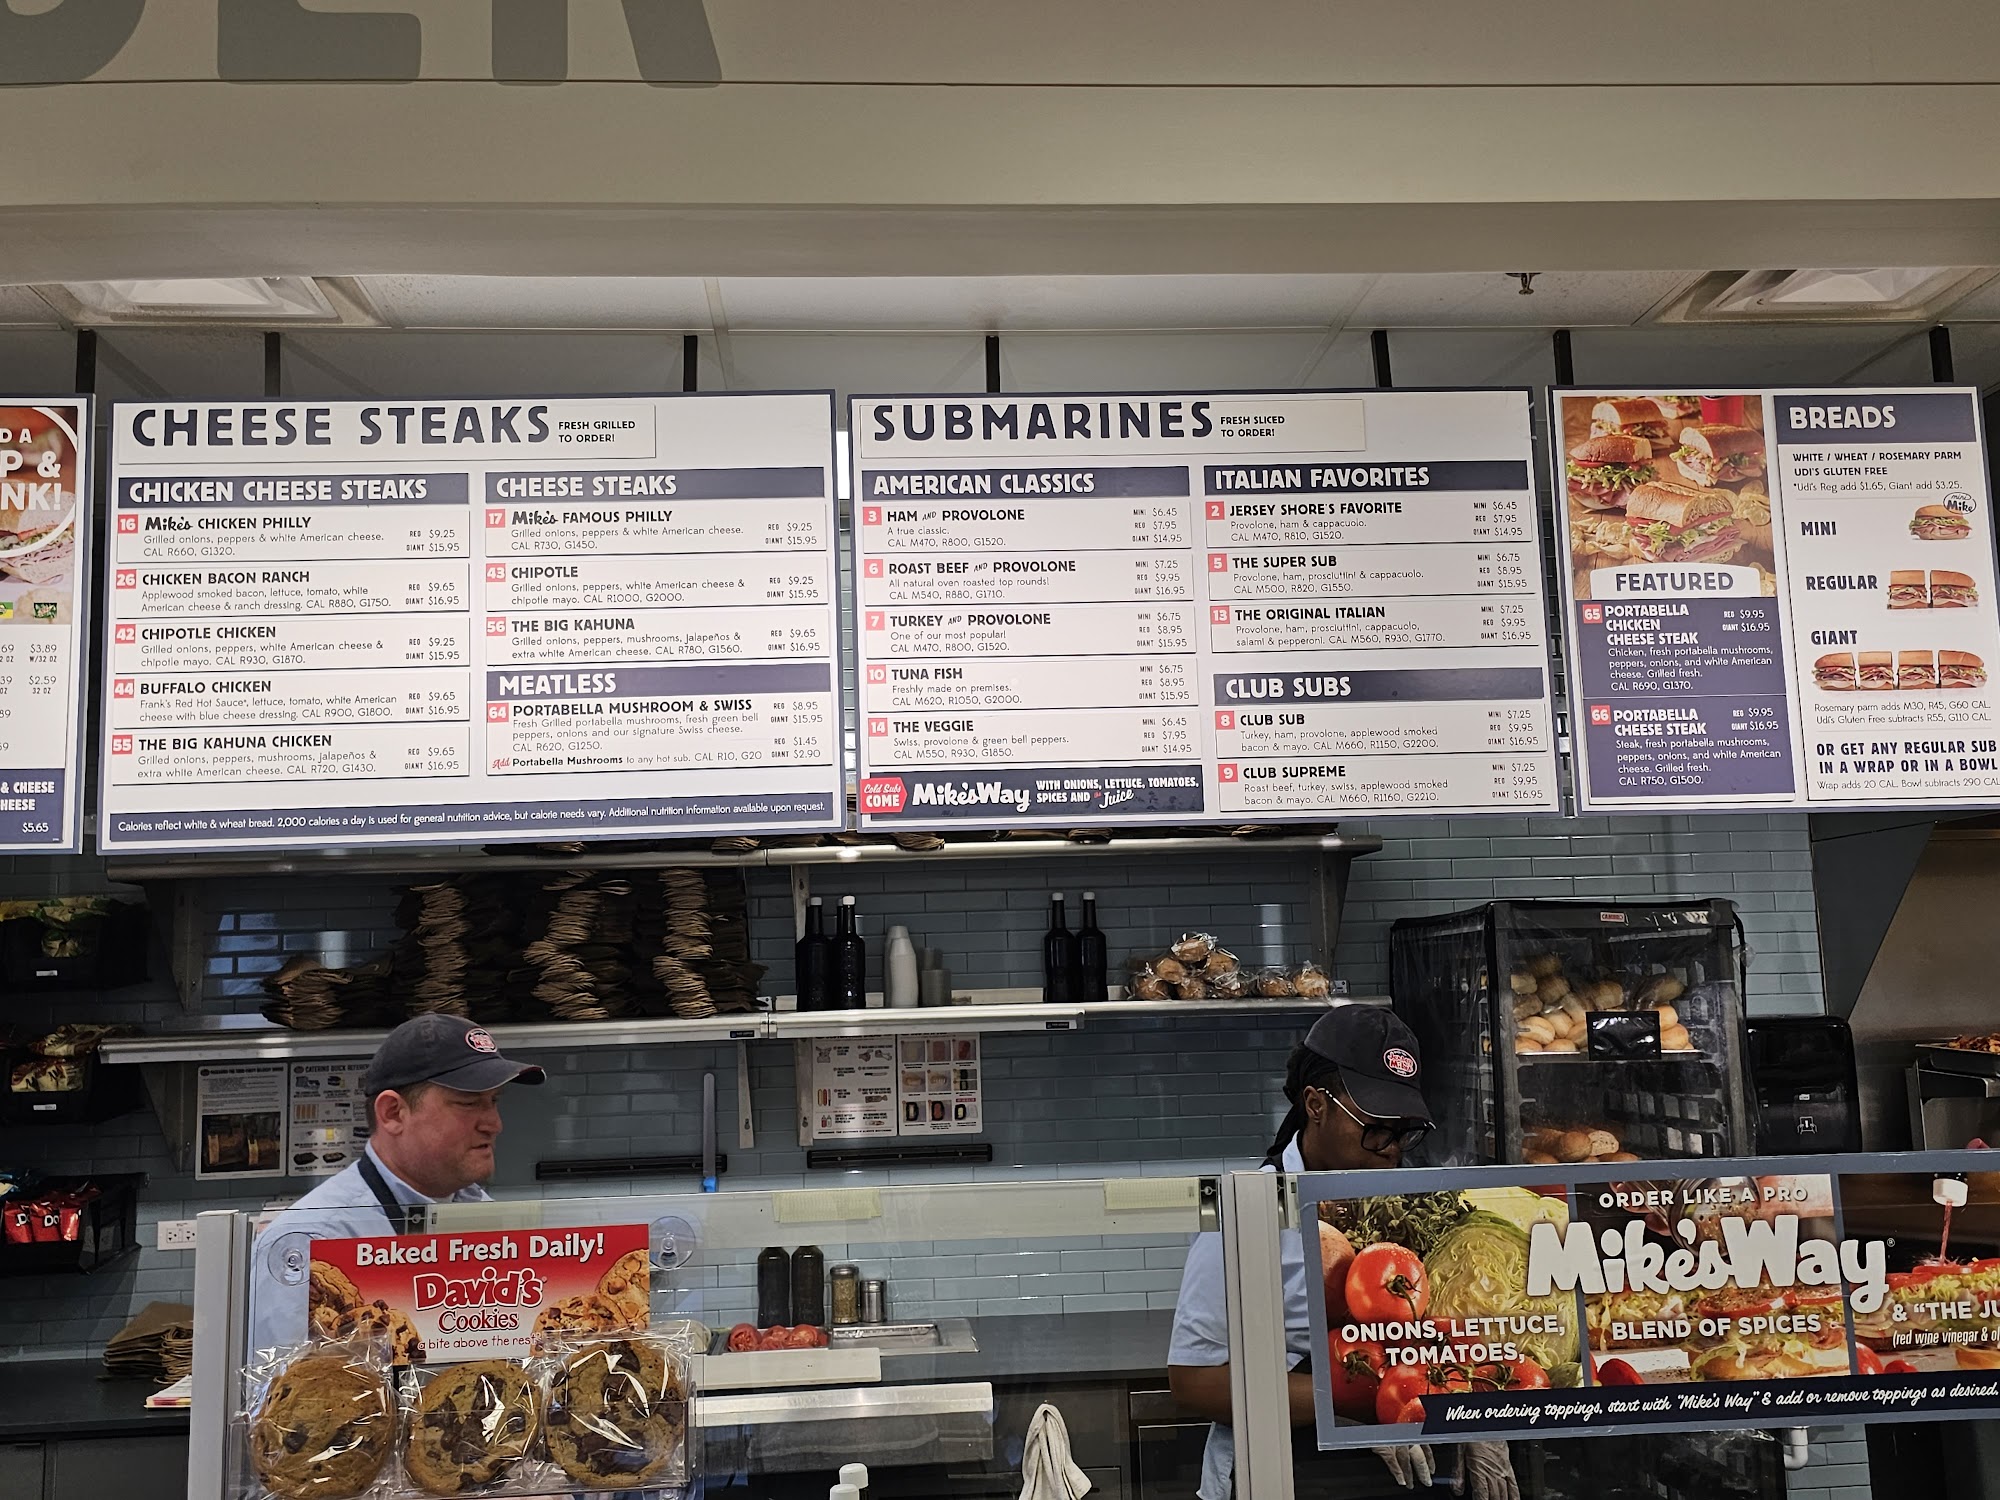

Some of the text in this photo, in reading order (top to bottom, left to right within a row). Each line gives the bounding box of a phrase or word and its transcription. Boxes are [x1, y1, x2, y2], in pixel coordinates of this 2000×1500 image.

[873, 401, 1213, 441] SUBMARINES
[1220, 416, 1284, 424] FRESH SLICED
[1790, 405, 1896, 429] BREADS
[132, 405, 548, 446] CHEESE STEAKS
[558, 420, 635, 430] FRESH GRILLED
[1220, 428, 1274, 437] TO ORDER!
[19, 428, 32, 443] A
[558, 434, 614, 442] TO ORDER!
[1793, 451, 1962, 462] WHITE / WHEAT / ROSEMARY PARM
[36, 451, 62, 478] &
[1794, 467, 1888, 477] UDI'S GLUTEN FREE
[873, 473, 1094, 494] AMERICAN CLASSICS
[1215, 466, 1429, 489] ITALIAN FAVORITES
[130, 478, 426, 502] CHICKEN CHEESE STEAKS
[496, 475, 676, 497] CHEESE STEAKS
[1152, 506, 1177, 517] $6.45
[1211, 502, 1401, 517] 2 JERSEY SHORE'S FAVORITE
[1947, 501, 1973, 512] Mike
[488, 510, 672, 525] 17 Mike's FAMOUS PHILLY
[868, 509, 1024, 522] 3 HAM AND PROVOLONE
[119, 516, 311, 531] 16 Mike's CHICKEN PHILLY
[887, 526, 949, 535] A true classic.
[1801, 522, 1837, 536] MINI
[143, 532, 383, 545] Grilled onions, peppers & white American cheese.
[429, 529, 455, 539] $9.25
[143, 546, 234, 556] CAL R660, G1320.
[429, 542, 460, 552] $15.95
[117, 571, 309, 586] 26 CHICKEN BACON RANCH
[1616, 572, 1734, 592] FEATURED
[1806, 575, 1878, 590] REGULAR
[1584, 604, 1690, 620] 65 PORTABELLA
[1740, 610, 1765, 619] $9.95
[1606, 619, 1661, 631] CHICKEN
[1741, 622, 1770, 632] $16.95
[1607, 632, 1699, 646] CHEESE STEAK
[1811, 630, 1857, 645] GIANT
[31, 644, 57, 654] $3.89
[50, 655, 57, 663] OZ
[29, 675, 57, 685] $2.59
[868, 667, 962, 681] 10 TUNA FISH
[114, 680, 270, 696] 44 BUFFALO CHICKEN
[499, 672, 616, 695] MEATLESS
[1226, 676, 1350, 698] CLUB SUBS
[488, 699, 751, 719] 64 PORTABELLA MUSHROOM & SWISS
[1223, 765, 1345, 780] 9 CLUB SUPREME
[1, 781, 55, 794] & CHEESE
[864, 784, 901, 795] Cold Subs
[1036, 777, 1199, 791] WITH ONIONS, LETTUCE, TOMATOES,
[866, 794, 900, 808] COME
[1037, 792, 1068, 803] SPICES
[1070, 791, 1090, 803] AND
[1099, 789, 1134, 808] Juice
[22, 822, 49, 833] $5.65
[1600, 1186, 1809, 1208] ORDER LIKE A PRO
[356, 1233, 604, 1266] Baked Fresh Daily!
[413, 1267, 544, 1311] David's
[1892, 1304, 1907, 1321] &
[438, 1308, 519, 1334] Cookies
[1341, 1315, 1565, 1342] ONIONS, LETTUCE,
[1612, 1314, 1821, 1341] BLEND OF SPICES
[429, 1339, 450, 1349] bite
[454, 1337, 488, 1348] above
[492, 1335, 510, 1346] the
[1893, 1329, 1912, 1348] (red
[1915, 1328, 1939, 1343] wine
[1942, 1328, 1979, 1346] vinegar
[1981, 1327, 1988, 1342] &
[1385, 1342, 1525, 1366] TOMATOES,
[1446, 1405, 1482, 1421] When
[1485, 1404, 1541, 1424] ordering
[1544, 1401, 1603, 1421] toppings,
[1608, 1400, 1640, 1413] start
[1642, 1396, 1672, 1412] with
[1776, 1390, 1804, 1404] add
[1806, 1394, 1822, 1404] or
[1824, 1390, 1870, 1403] remove
[1872, 1386, 1927, 1406] toppings
[1931, 1387, 1945, 1398] as
[1949, 1382, 1998, 1397] desired.
